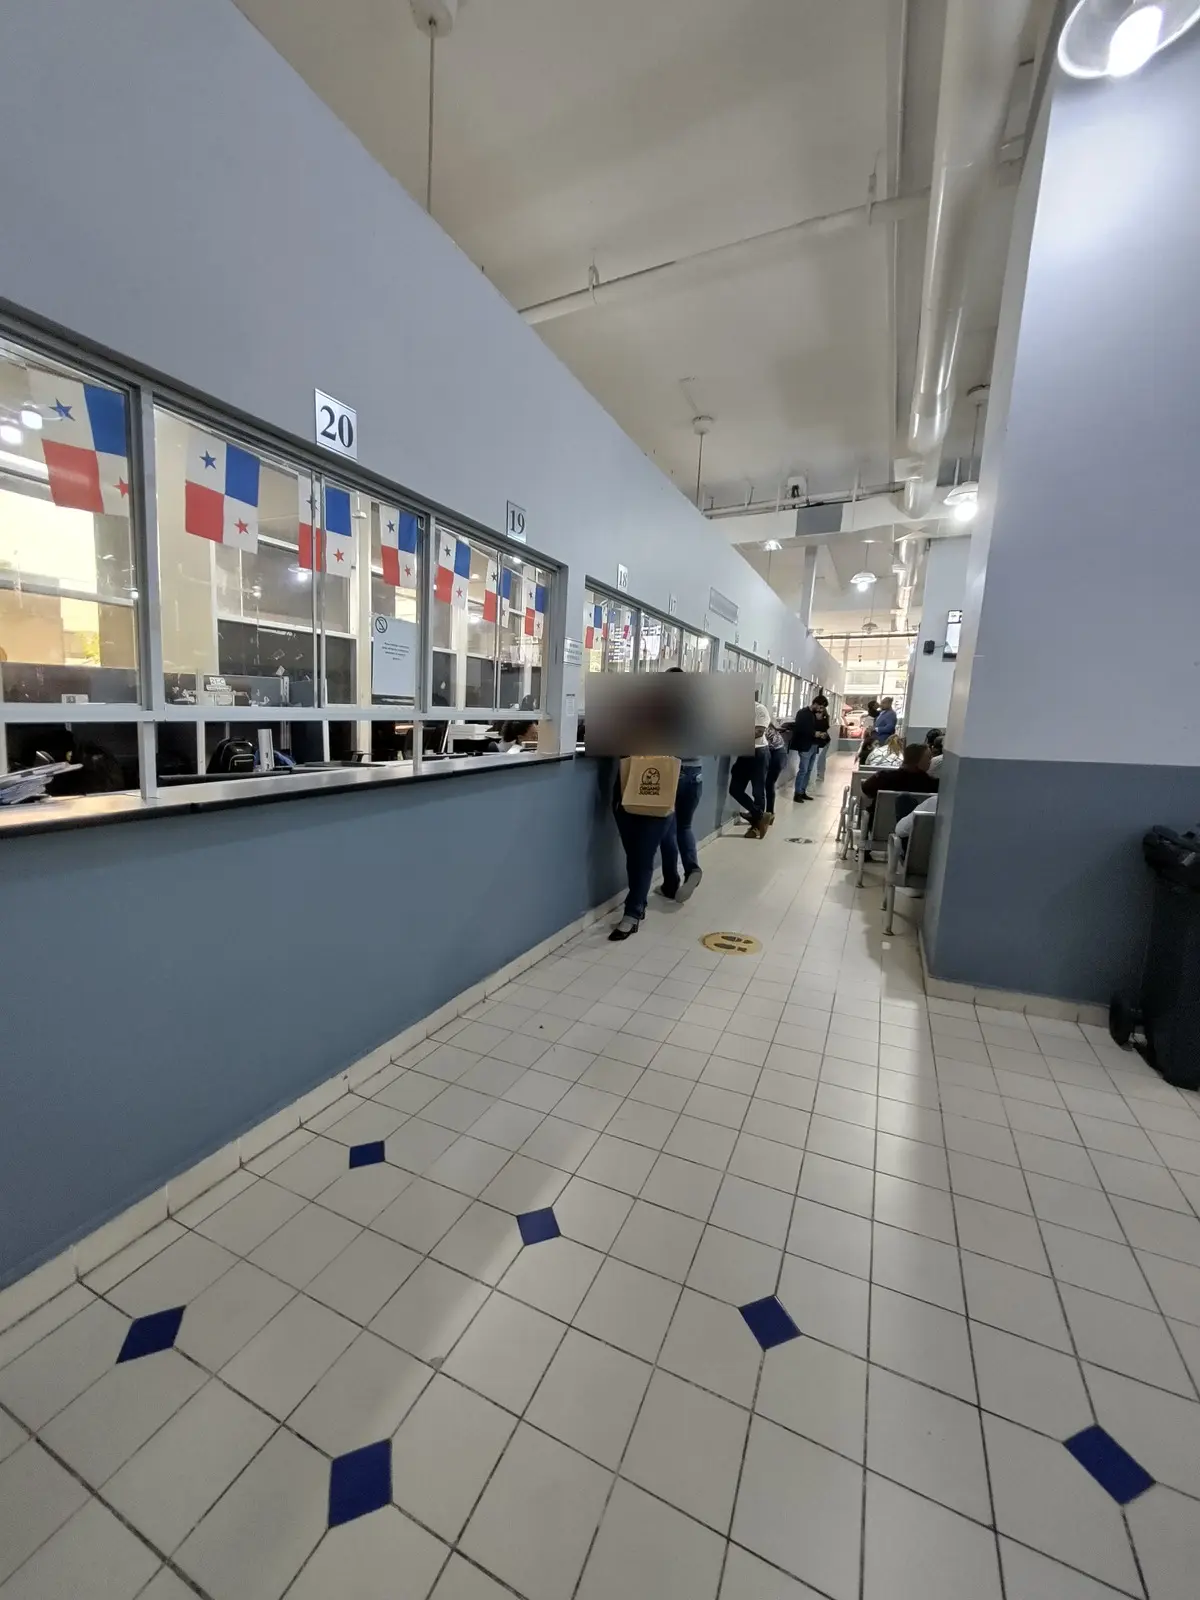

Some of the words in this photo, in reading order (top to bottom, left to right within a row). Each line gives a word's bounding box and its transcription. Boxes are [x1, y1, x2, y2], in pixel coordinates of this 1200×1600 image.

[320, 405, 354, 448] 20
[510, 510, 525, 534] 19
[619, 570, 628, 588] 18
